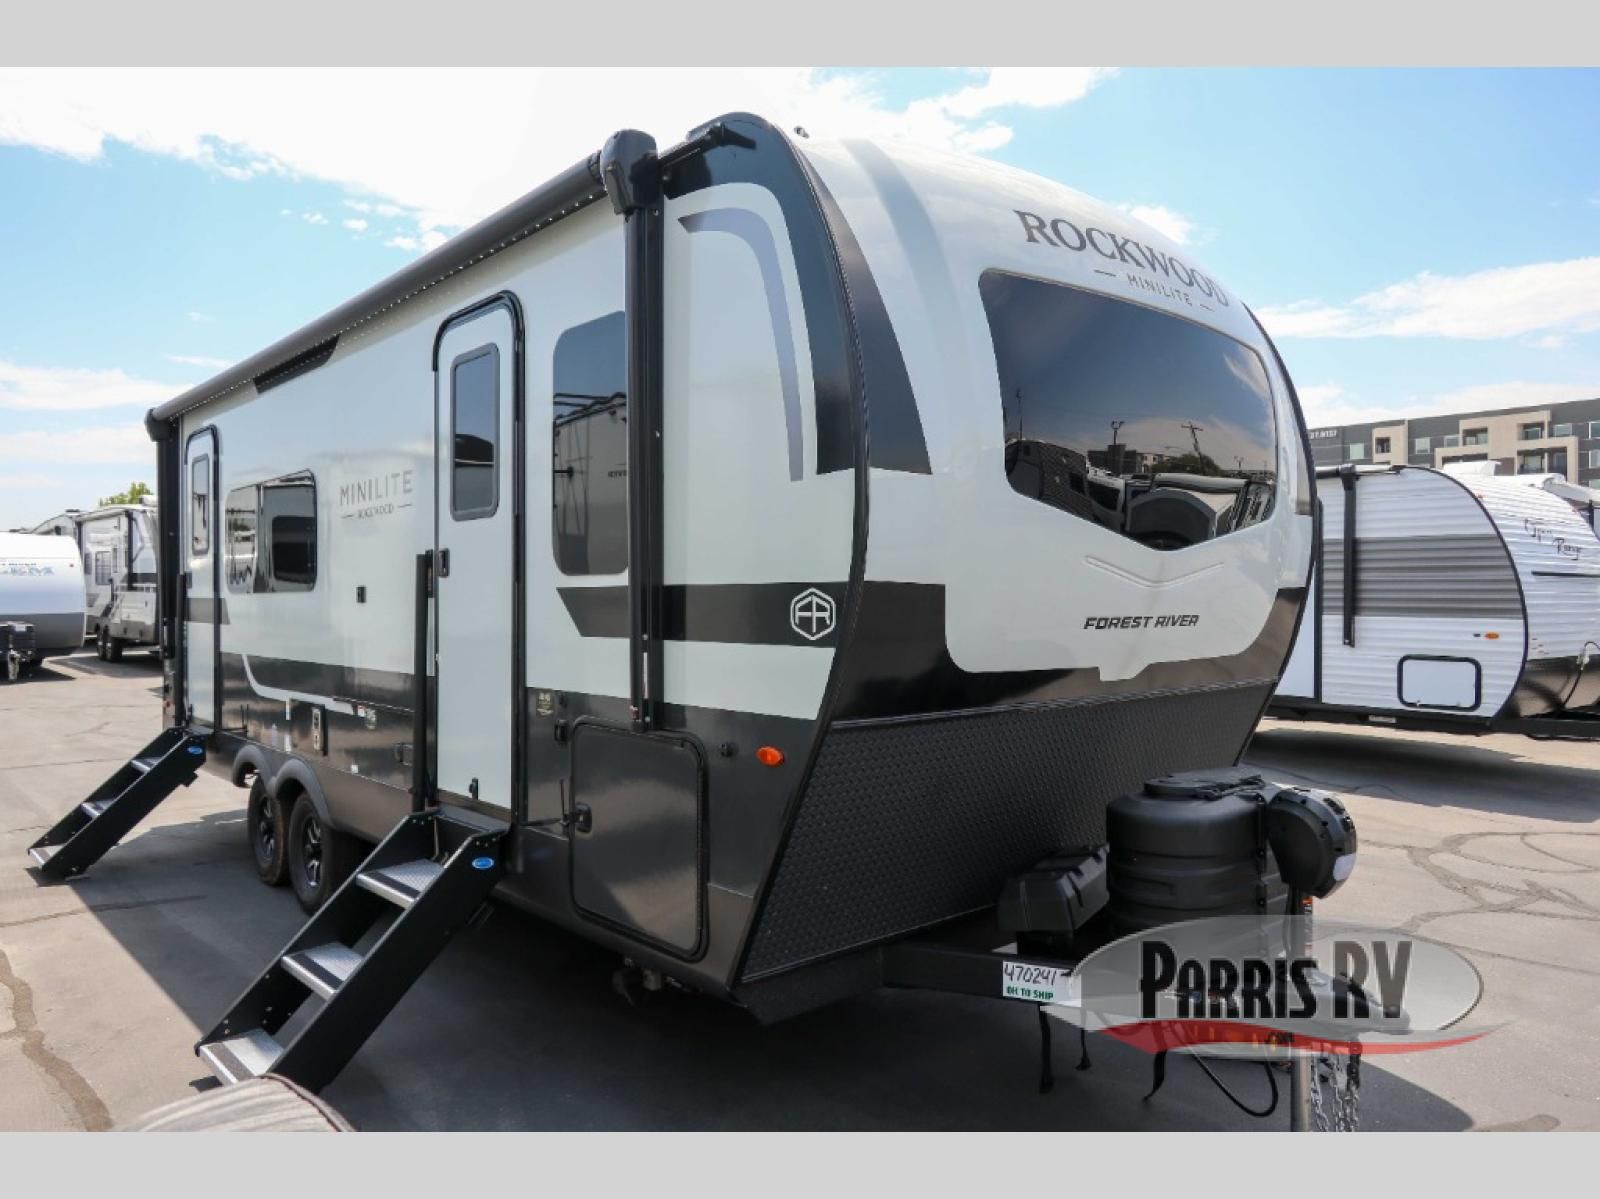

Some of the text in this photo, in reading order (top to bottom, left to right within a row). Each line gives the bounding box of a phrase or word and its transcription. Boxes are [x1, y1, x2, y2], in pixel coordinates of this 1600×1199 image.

[1013, 208, 1230, 307] ROCKWOOD
[1126, 272, 1193, 307] MINILITE
[339, 469, 413, 506] MINILITE
[1083, 614, 1200, 629] FOREST RIVER
[1004, 962, 1057, 986] 470241
[1020, 987, 1031, 998] TO
[1033, 989, 1054, 1000] SHIP
